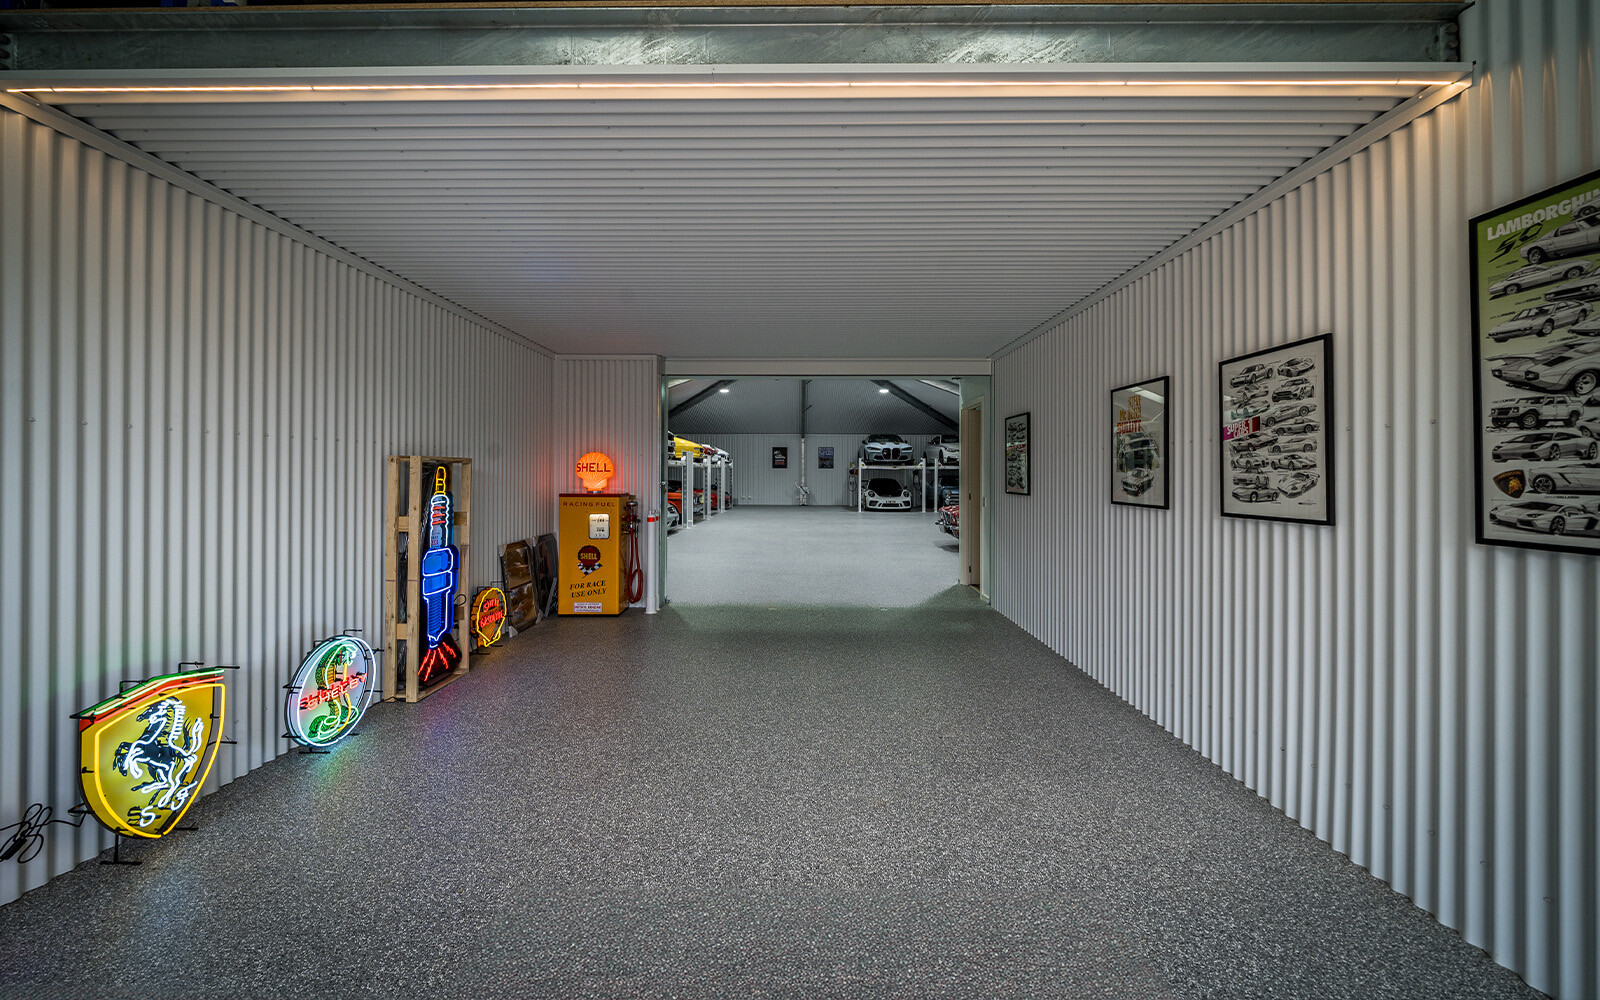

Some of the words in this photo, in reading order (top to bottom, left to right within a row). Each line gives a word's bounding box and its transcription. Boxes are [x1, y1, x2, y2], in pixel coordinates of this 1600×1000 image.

[1227, 421, 1246, 435] SUPER
[576, 462, 611, 473] SHELL
[580, 552, 598, 560] SHELL
[569, 582, 585, 591] FOR
[586, 580, 607, 588] RACE
[571, 590, 586, 599] USE
[587, 588, 607, 597] ONLY
[304, 673, 367, 711] SHELBY
